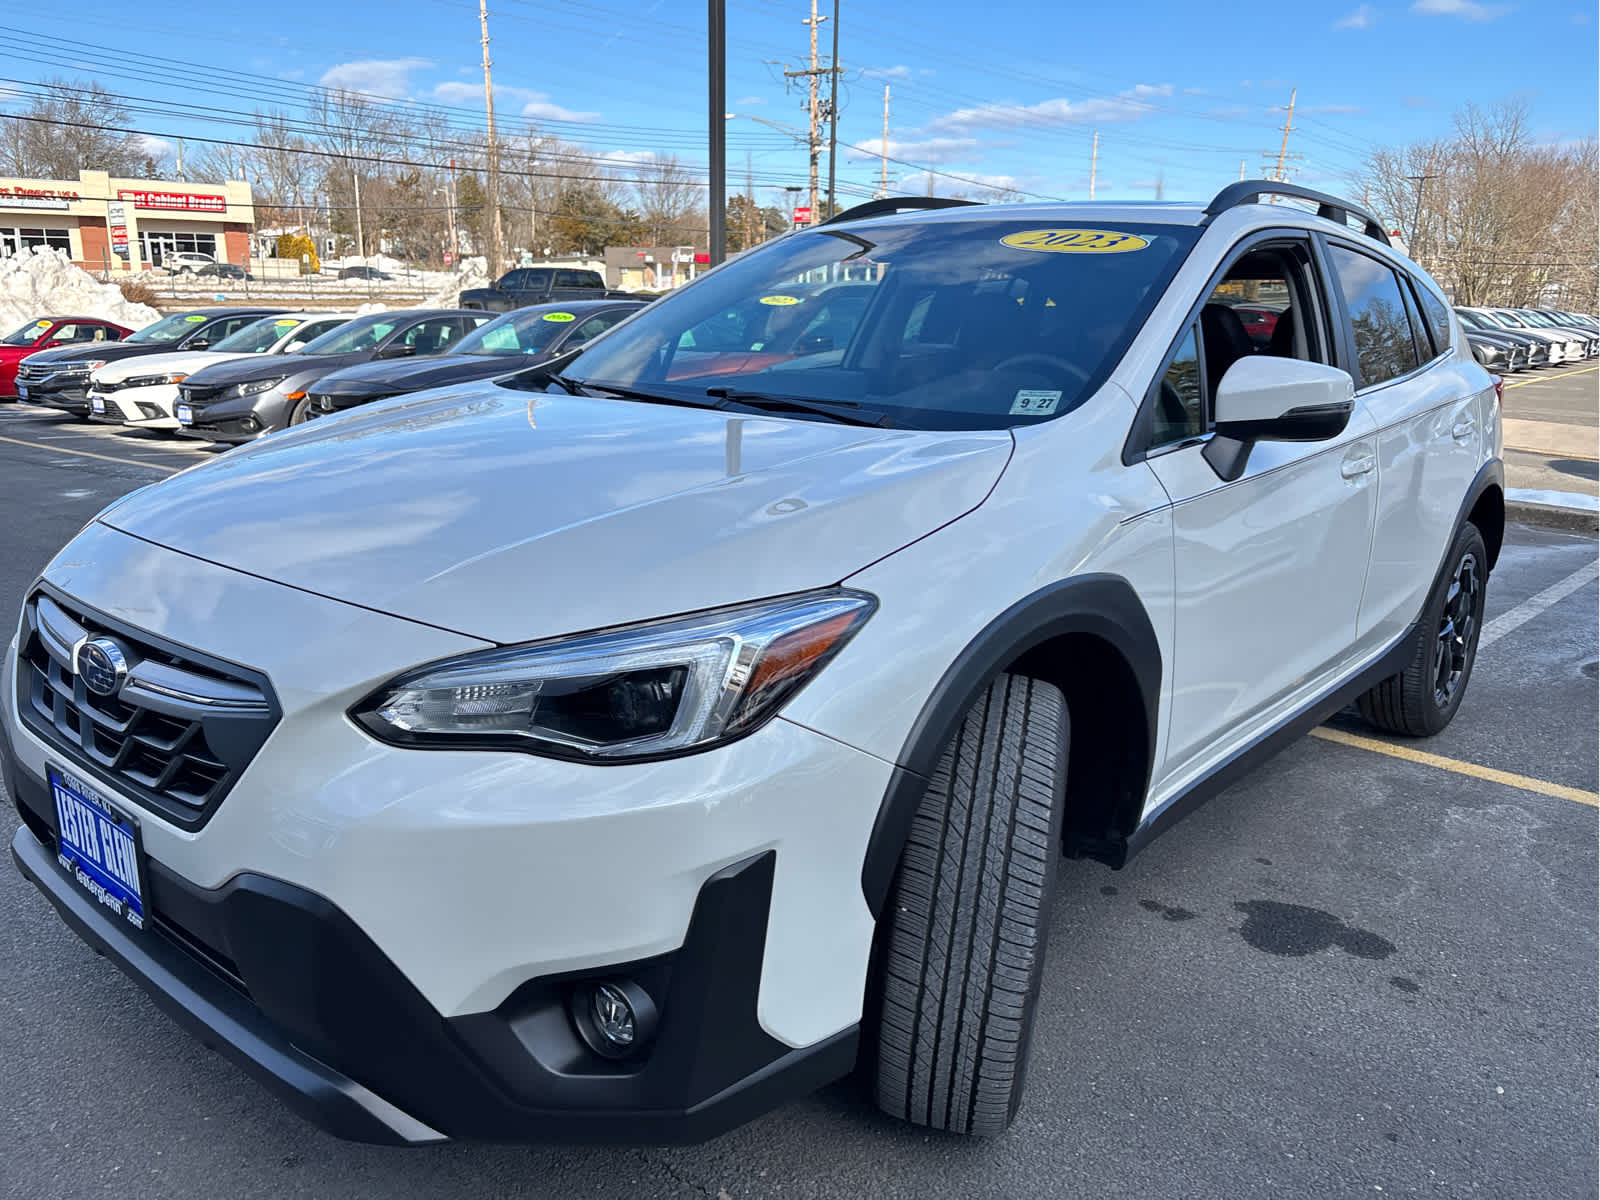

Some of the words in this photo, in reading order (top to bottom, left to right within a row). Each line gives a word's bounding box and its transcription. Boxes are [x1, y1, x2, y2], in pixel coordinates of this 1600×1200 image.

[147, 194, 187, 208] Cabinet
[188, 196, 223, 210] Brands
[1014, 232, 1130, 248] 2023
[1020, 398, 1030, 408] 9
[1036, 398, 1054, 409] 27
[54, 787, 101, 865] LESTER
[100, 818, 141, 896] GLENN
